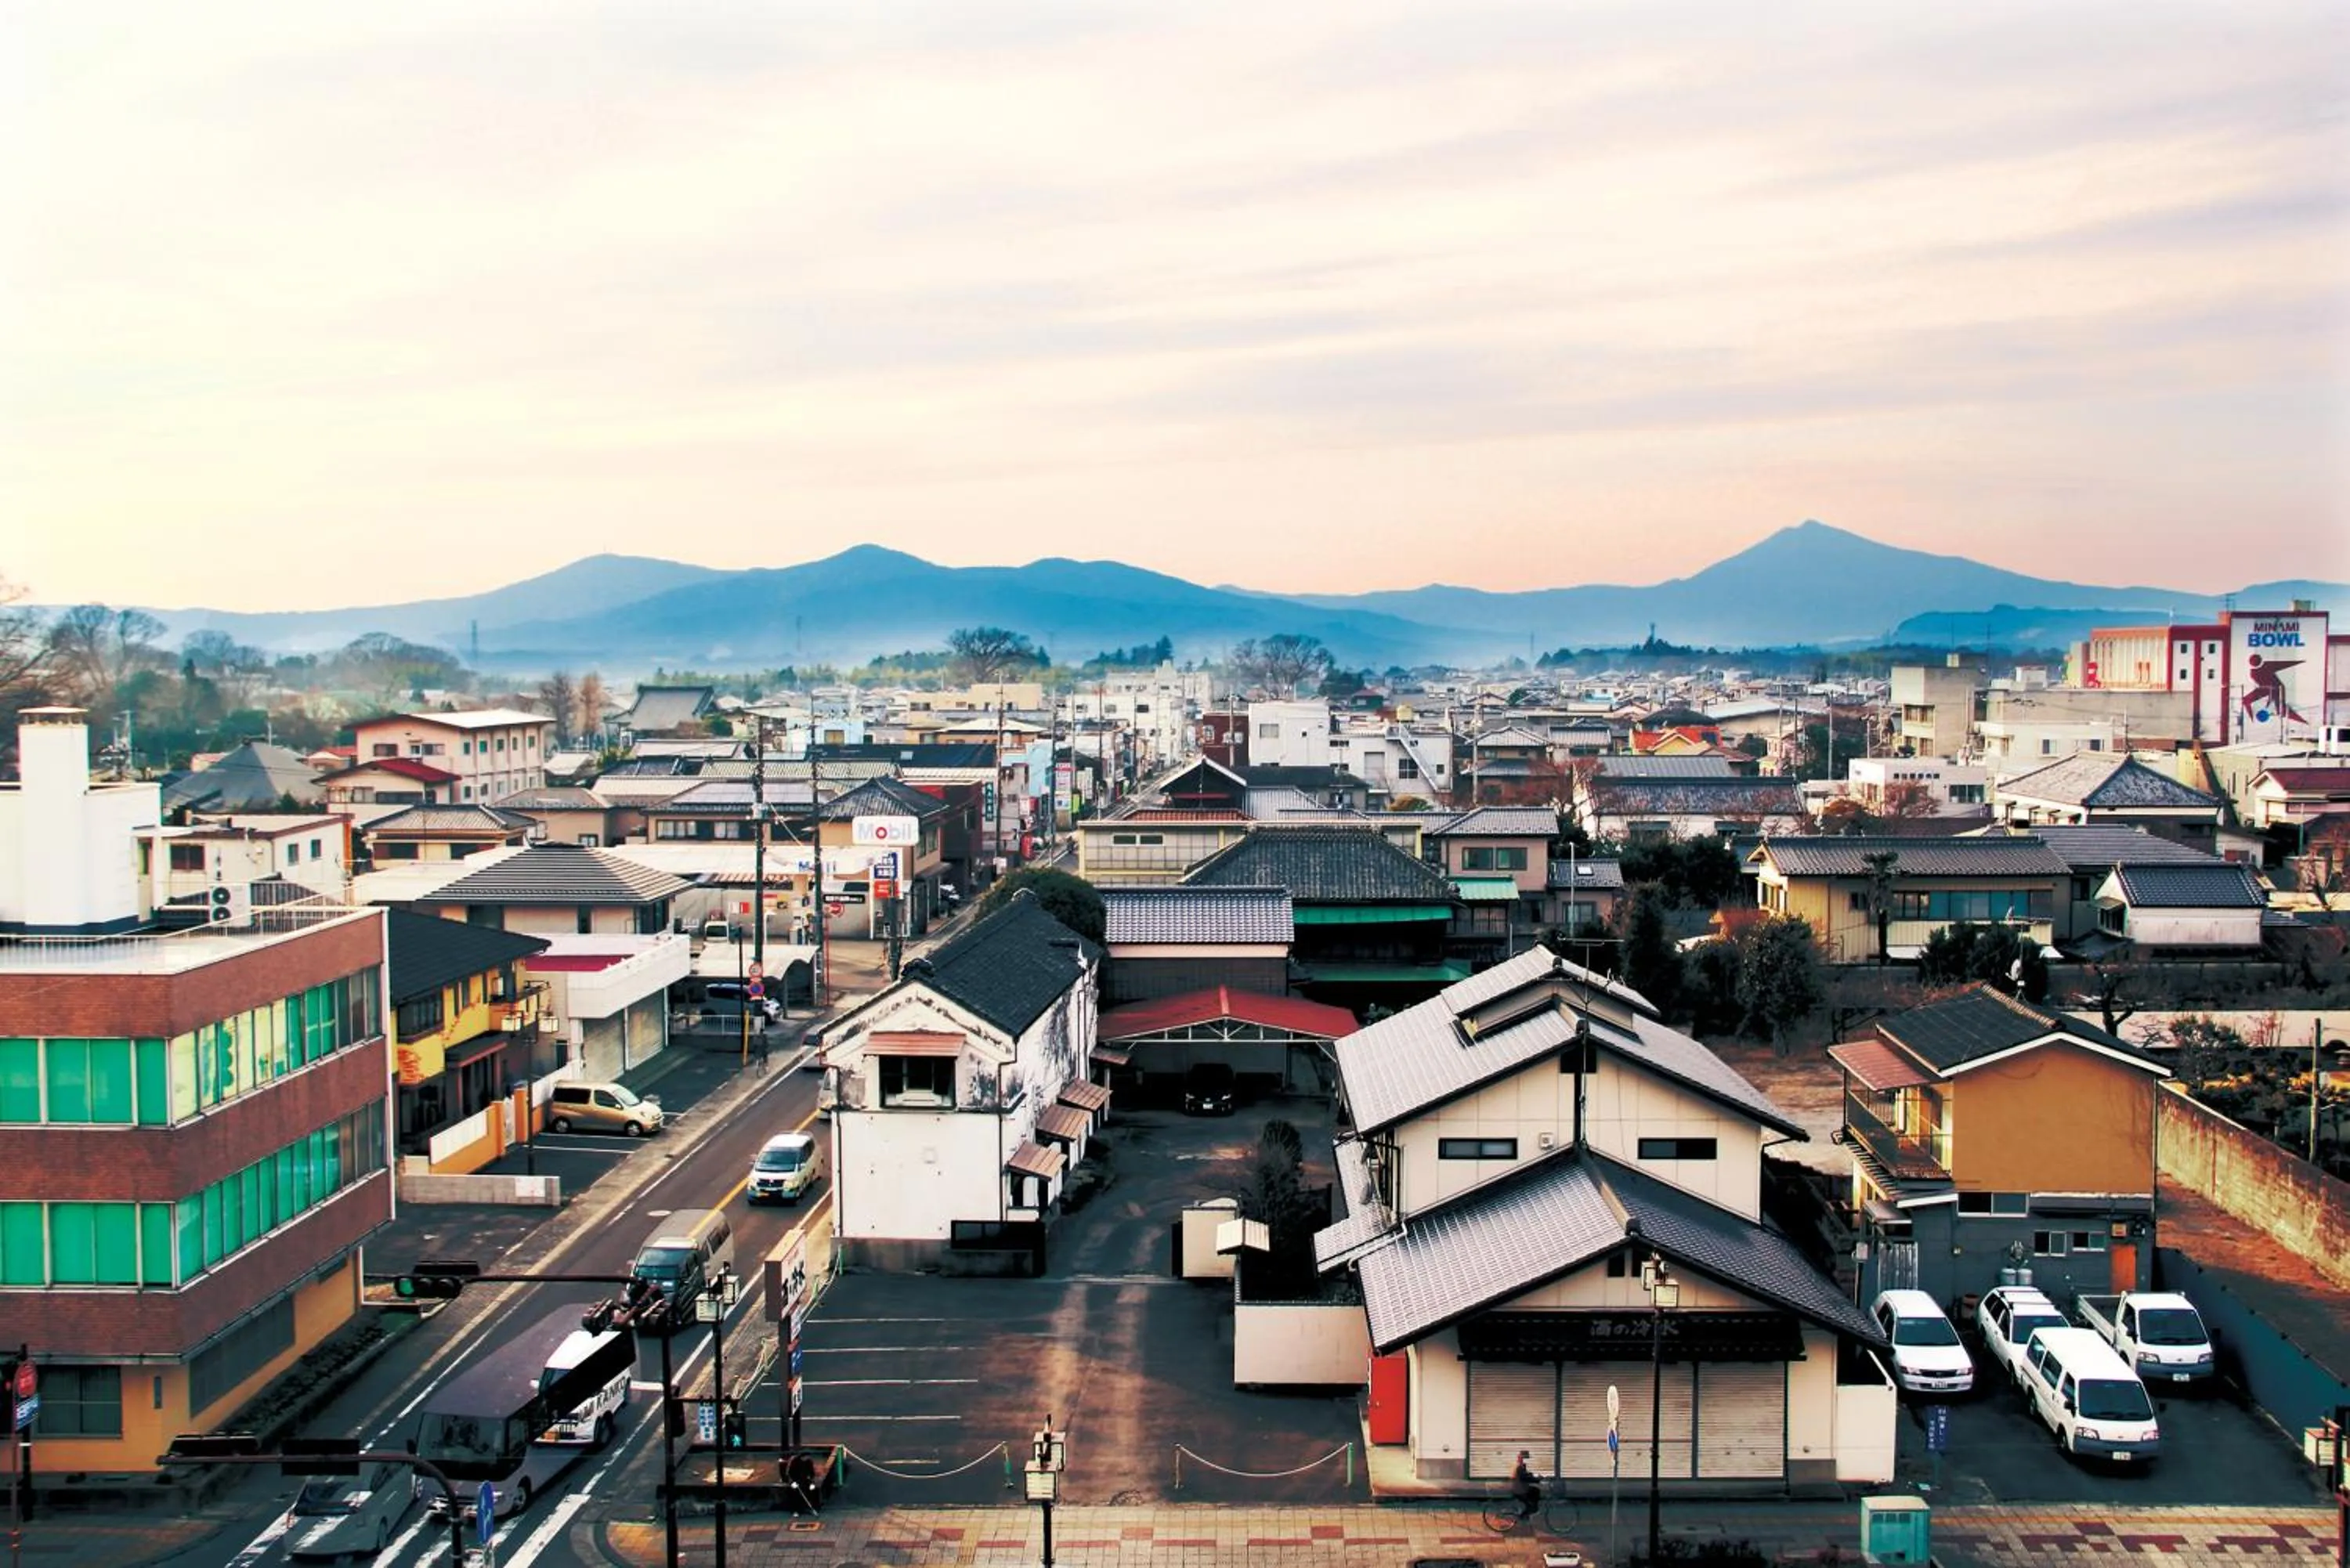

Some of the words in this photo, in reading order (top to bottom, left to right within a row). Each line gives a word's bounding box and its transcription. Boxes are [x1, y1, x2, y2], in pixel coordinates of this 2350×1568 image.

[2254, 621, 2300, 632] MINAMI
[2247, 632, 2305, 647] BOWL
[858, 823, 912, 840] Mobil
